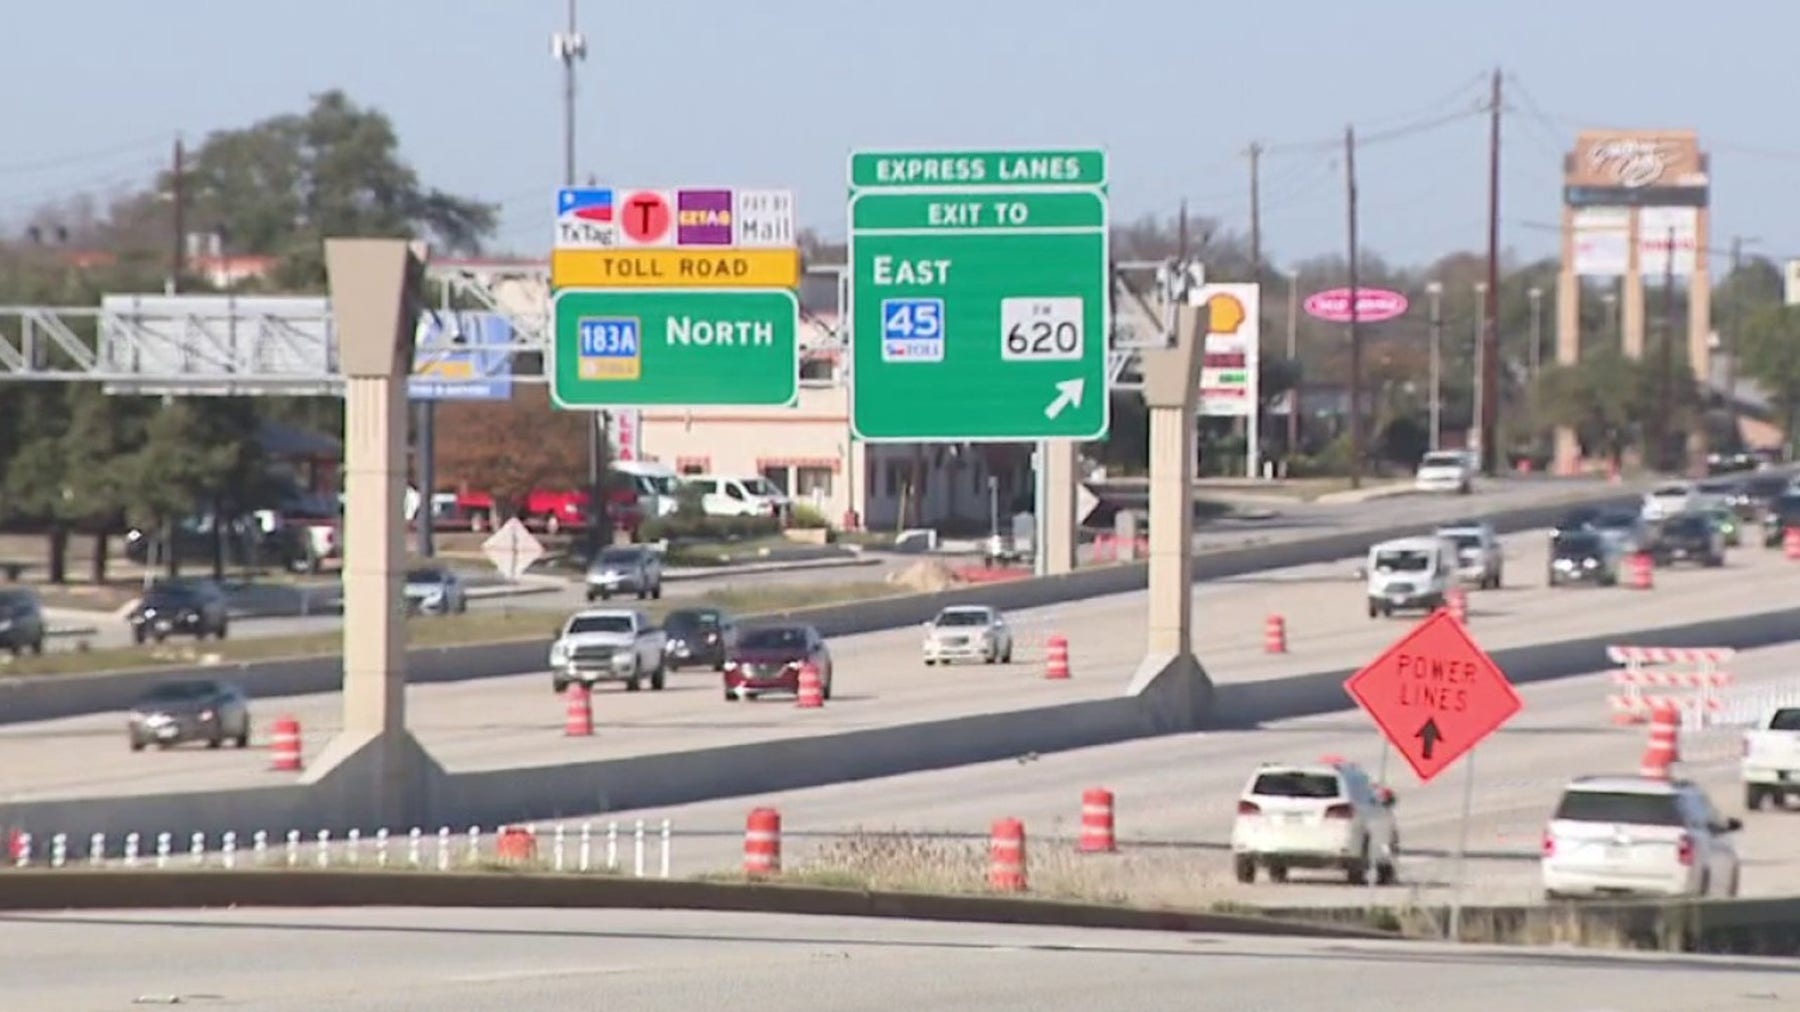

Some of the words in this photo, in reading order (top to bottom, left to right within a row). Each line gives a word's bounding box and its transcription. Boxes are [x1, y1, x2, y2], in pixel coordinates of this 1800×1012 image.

[876, 158, 986, 182] EXPRESS
[998, 157, 1081, 180] LANES
[633, 201, 660, 235] T
[928, 202, 982, 225] EXIT
[995, 202, 1029, 224] TO
[742, 218, 790, 240] Mail
[603, 258, 663, 277] TOLL
[680, 258, 749, 277] ROAD
[872, 256, 951, 285] EAST
[666, 316, 773, 346] NORTH
[888, 305, 938, 336] 45
[583, 325, 637, 352] 183A
[1008, 321, 1077, 354] 620
[1397, 654, 1477, 684] POWER
[1400, 683, 1468, 713] LINES
